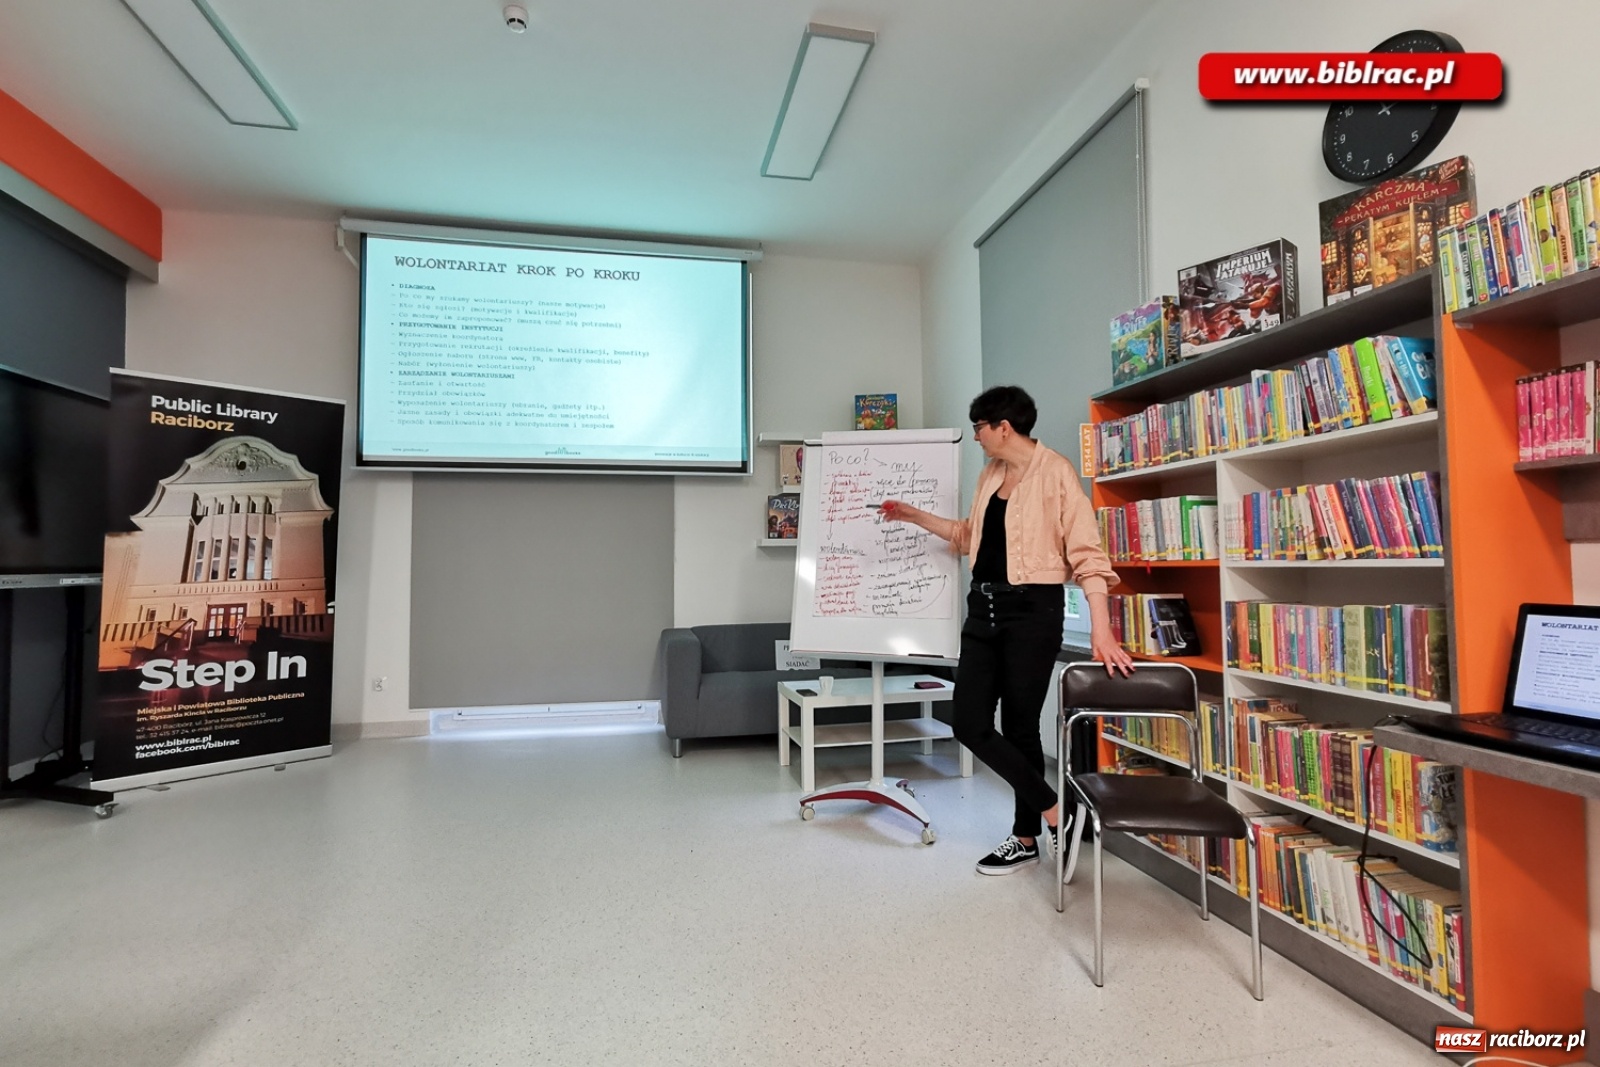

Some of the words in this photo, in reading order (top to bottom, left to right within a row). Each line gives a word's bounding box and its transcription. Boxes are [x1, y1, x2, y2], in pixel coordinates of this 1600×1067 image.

[1340, 134, 1346, 144] 9
[1412, 130, 1419, 142] 5
[1346, 152, 1352, 162] 8
[1363, 160, 1370, 170] 7
[1387, 153, 1394, 164] 6
[1354, 182, 1426, 212] KARCZMA
[1344, 204, 1390, 223] PĘKATYM
[394, 256, 507, 273] WOLONTARIAT
[517, 264, 556, 276] KROK
[566, 267, 584, 278] PO
[594, 269, 640, 281] KROKU
[1216, 250, 1272, 278] IMPERIUM
[1221, 260, 1267, 280] ATAKUJE
[151, 395, 212, 414] Public
[216, 403, 278, 424] Library
[151, 411, 234, 432] Raciborz
[1084, 428, 1092, 446] LAT
[829, 451, 843, 464] Po
[1084, 449, 1092, 472] 12-14
[1542, 622, 1599, 631] WOLONTARIAT
[139, 658, 255, 692] Step
[267, 651, 307, 680] In
[137, 706, 172, 715] Miejska
[178, 702, 225, 710] Powiatowa
[227, 696, 267, 705] Biblioteka
[268, 692, 304, 701] Publiczna
[150, 713, 183, 721] Ryszarda
[135, 734, 212, 751] www.biblrac.pl
[135, 739, 240, 759] facebook.com/biblrac
